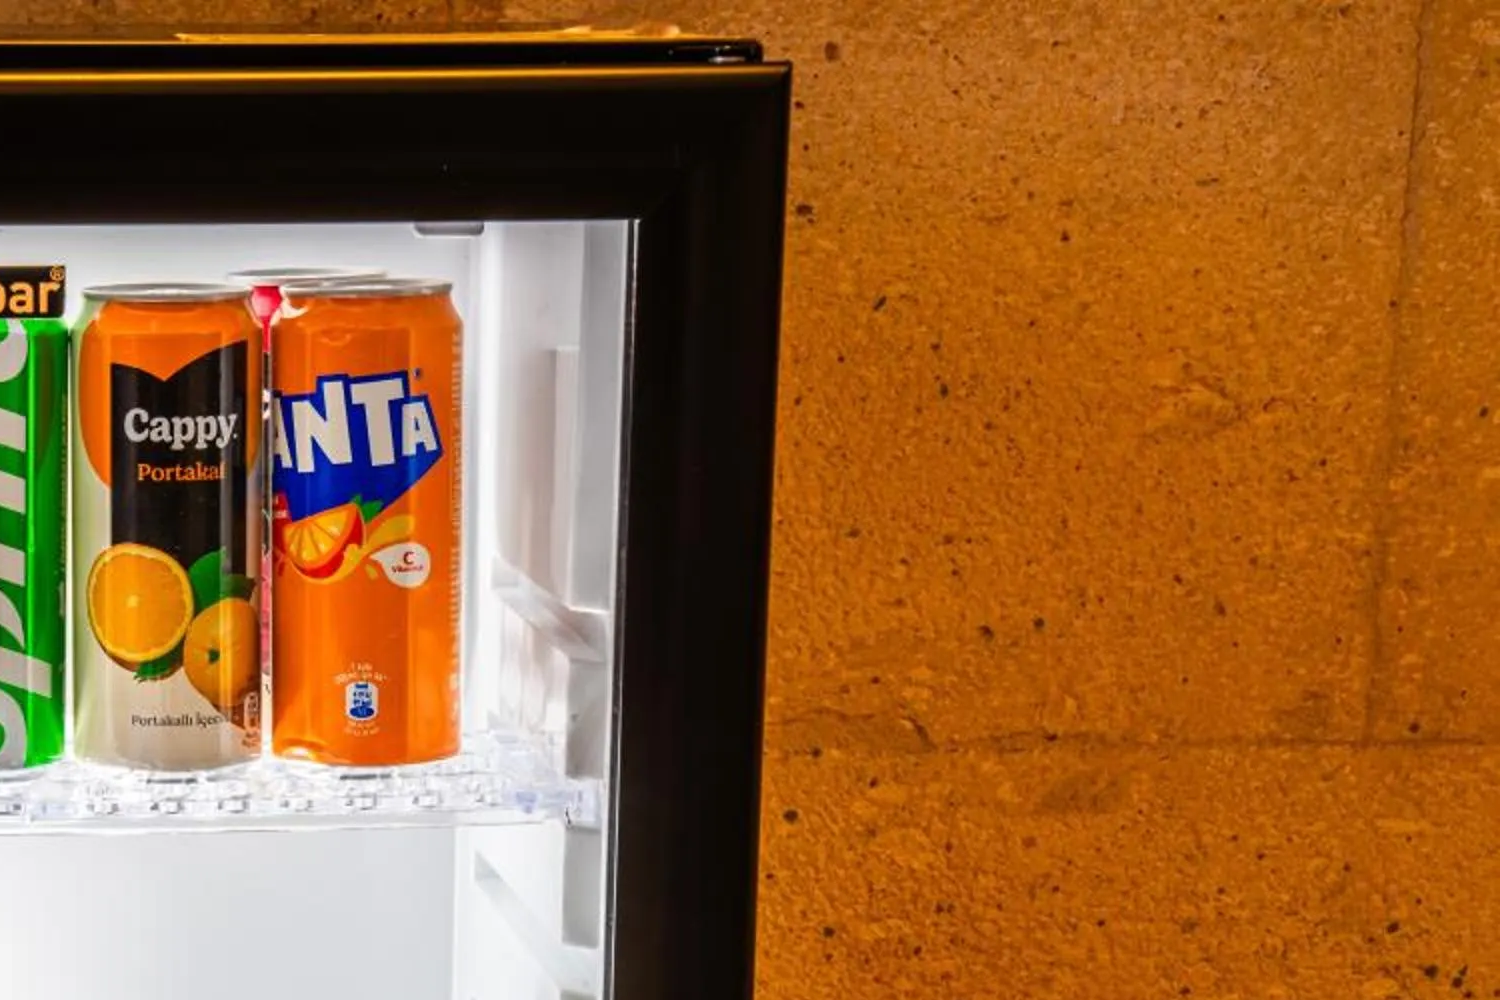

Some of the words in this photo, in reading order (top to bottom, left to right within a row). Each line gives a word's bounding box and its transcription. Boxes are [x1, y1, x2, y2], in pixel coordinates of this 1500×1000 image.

[124, 407, 237, 449] Cappy
[272, 380, 439, 473] ANTA
[138, 461, 227, 482] Portakal
[403, 551, 415, 565] C
